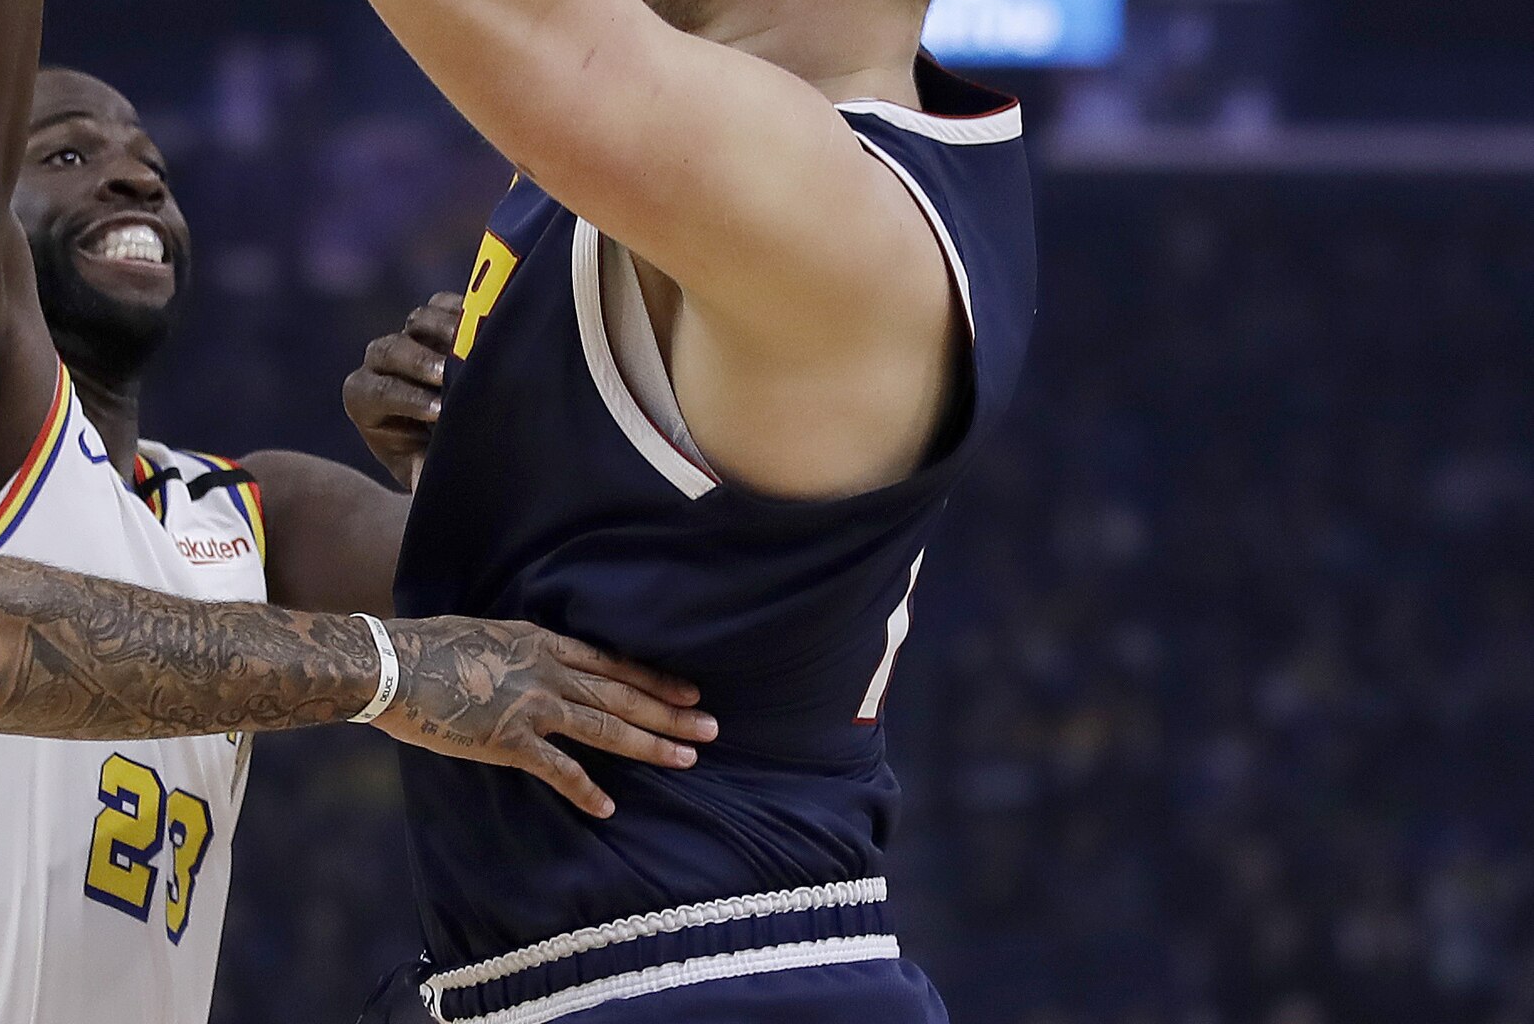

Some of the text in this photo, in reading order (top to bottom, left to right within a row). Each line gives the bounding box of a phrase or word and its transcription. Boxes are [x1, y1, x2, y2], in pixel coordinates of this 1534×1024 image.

[172, 533, 250, 559] akuten
[378, 676, 394, 703] DEUCE
[84, 752, 214, 947] 23
